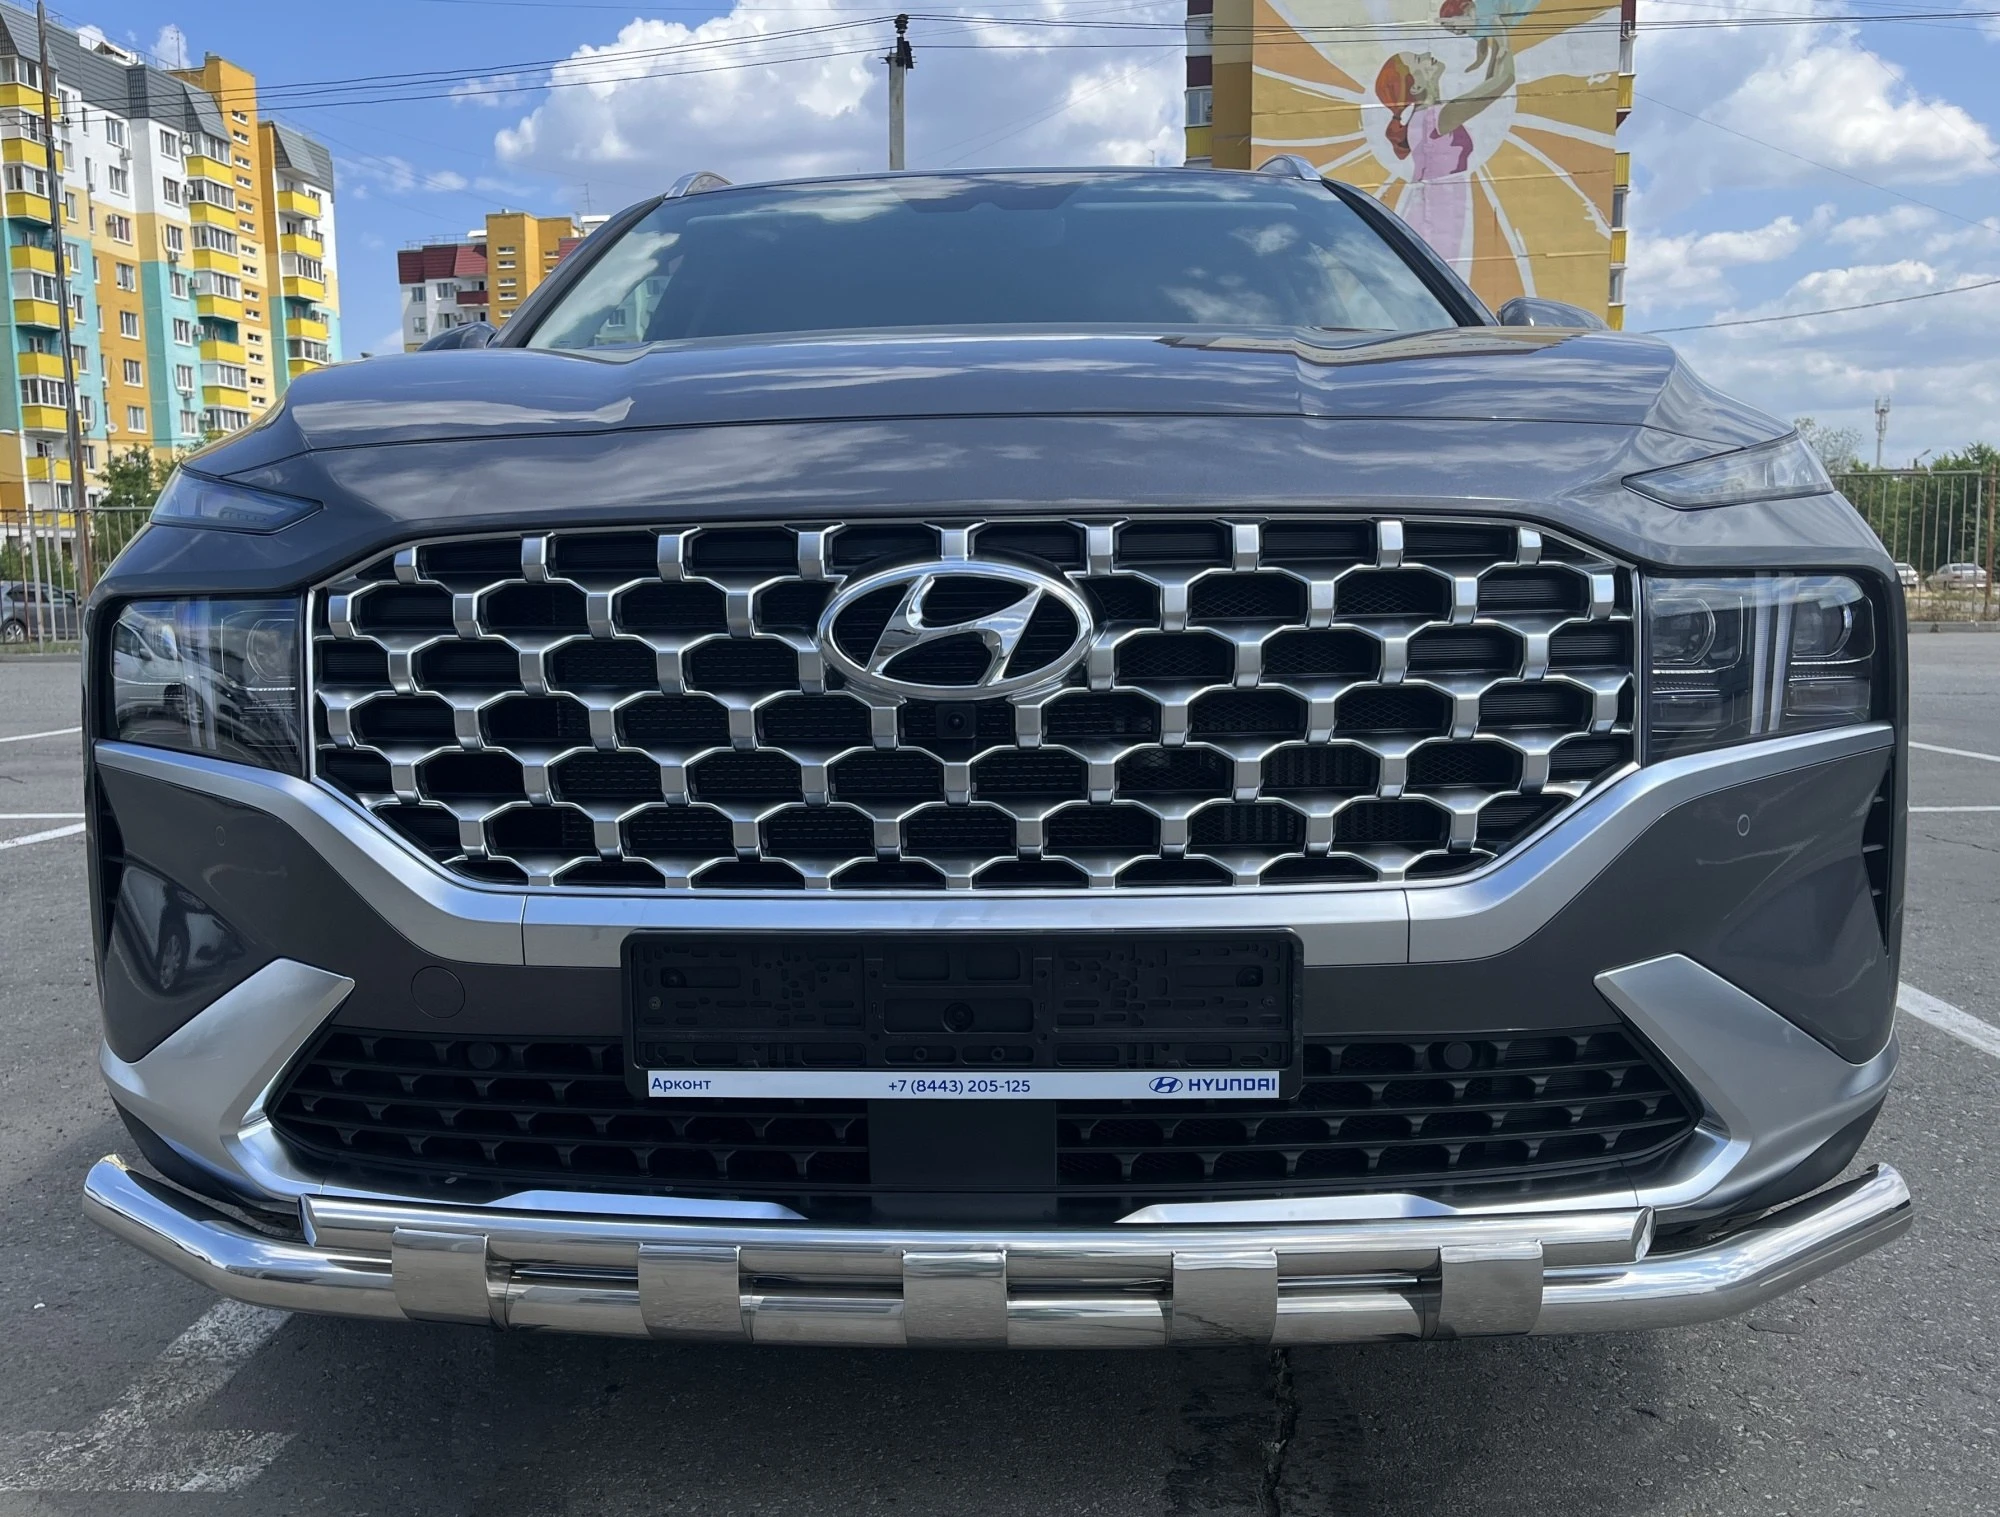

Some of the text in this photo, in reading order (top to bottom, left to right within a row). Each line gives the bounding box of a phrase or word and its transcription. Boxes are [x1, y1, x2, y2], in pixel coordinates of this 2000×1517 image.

[651, 1076, 711, 1092] Арконт
[888, 1079, 1031, 1096] +7 (8443) 205-125
[1188, 1077, 1276, 1092] HYUNDAI
